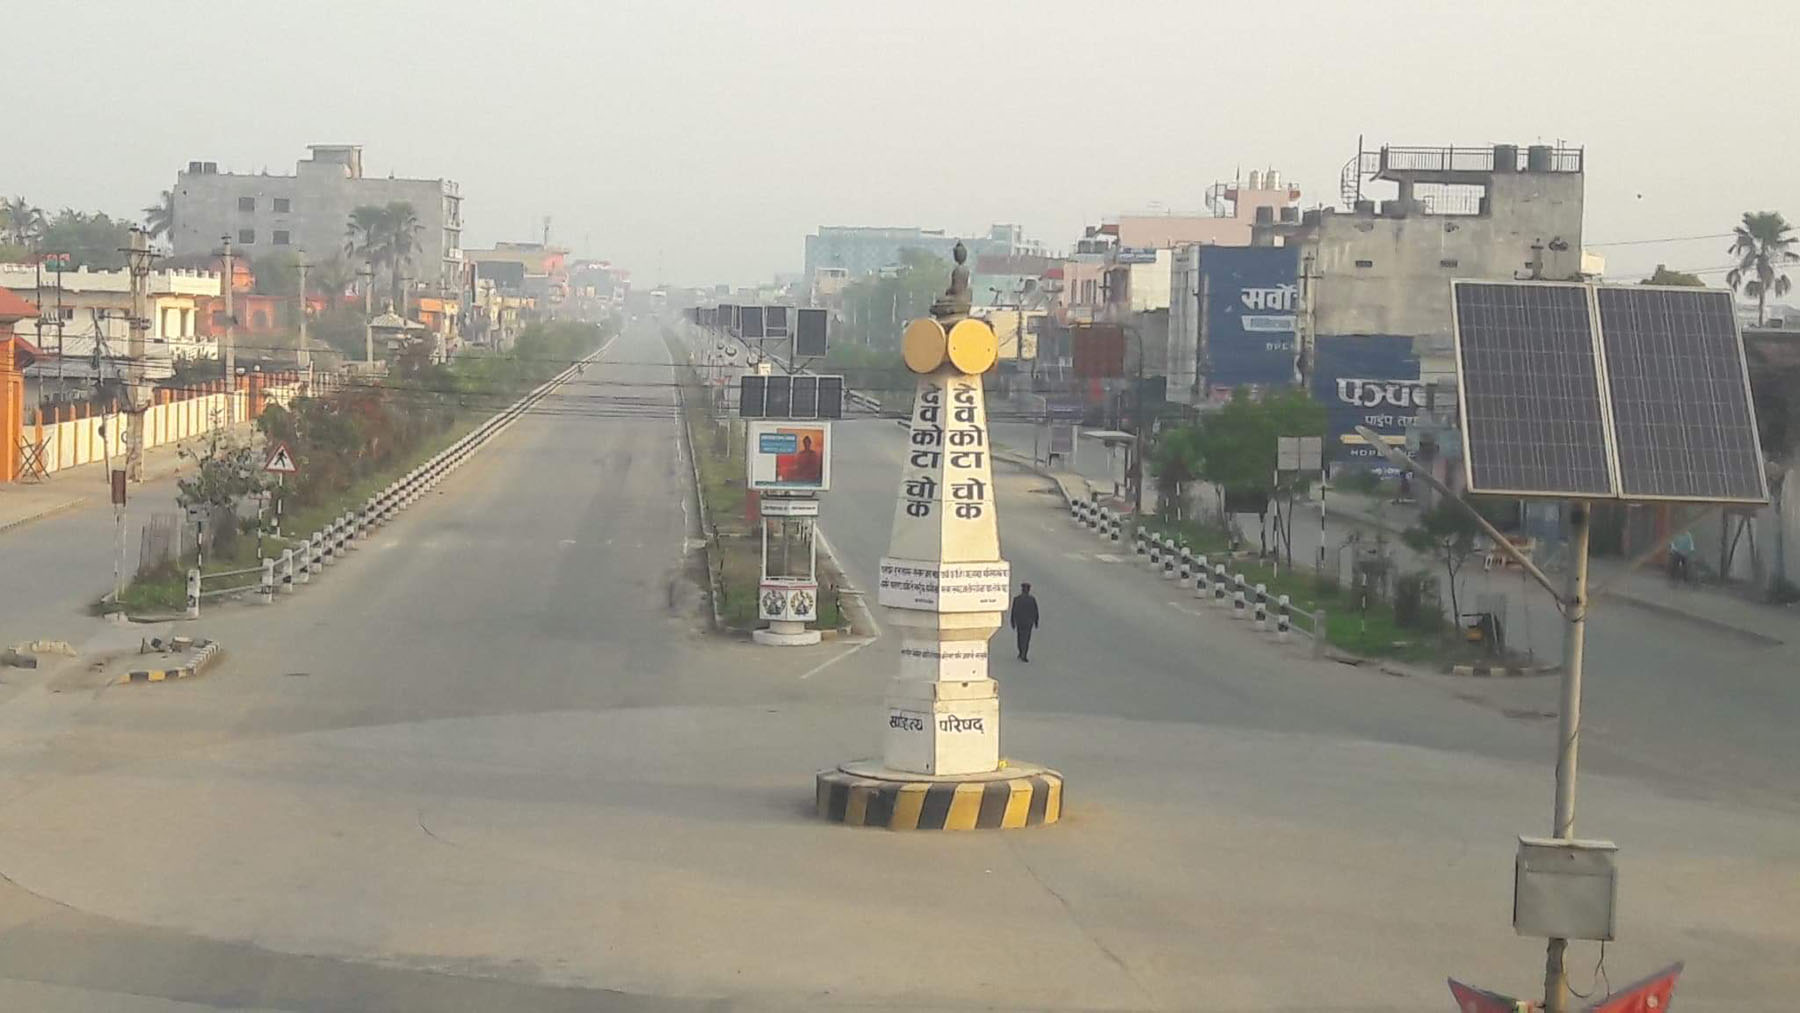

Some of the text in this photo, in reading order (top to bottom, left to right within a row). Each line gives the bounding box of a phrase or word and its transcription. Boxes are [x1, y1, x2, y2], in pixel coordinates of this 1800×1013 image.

[1241, 283, 1298, 311] सर्वो
[949, 382, 985, 469] देवकोटा
[939, 714, 984, 734] परिषद्
